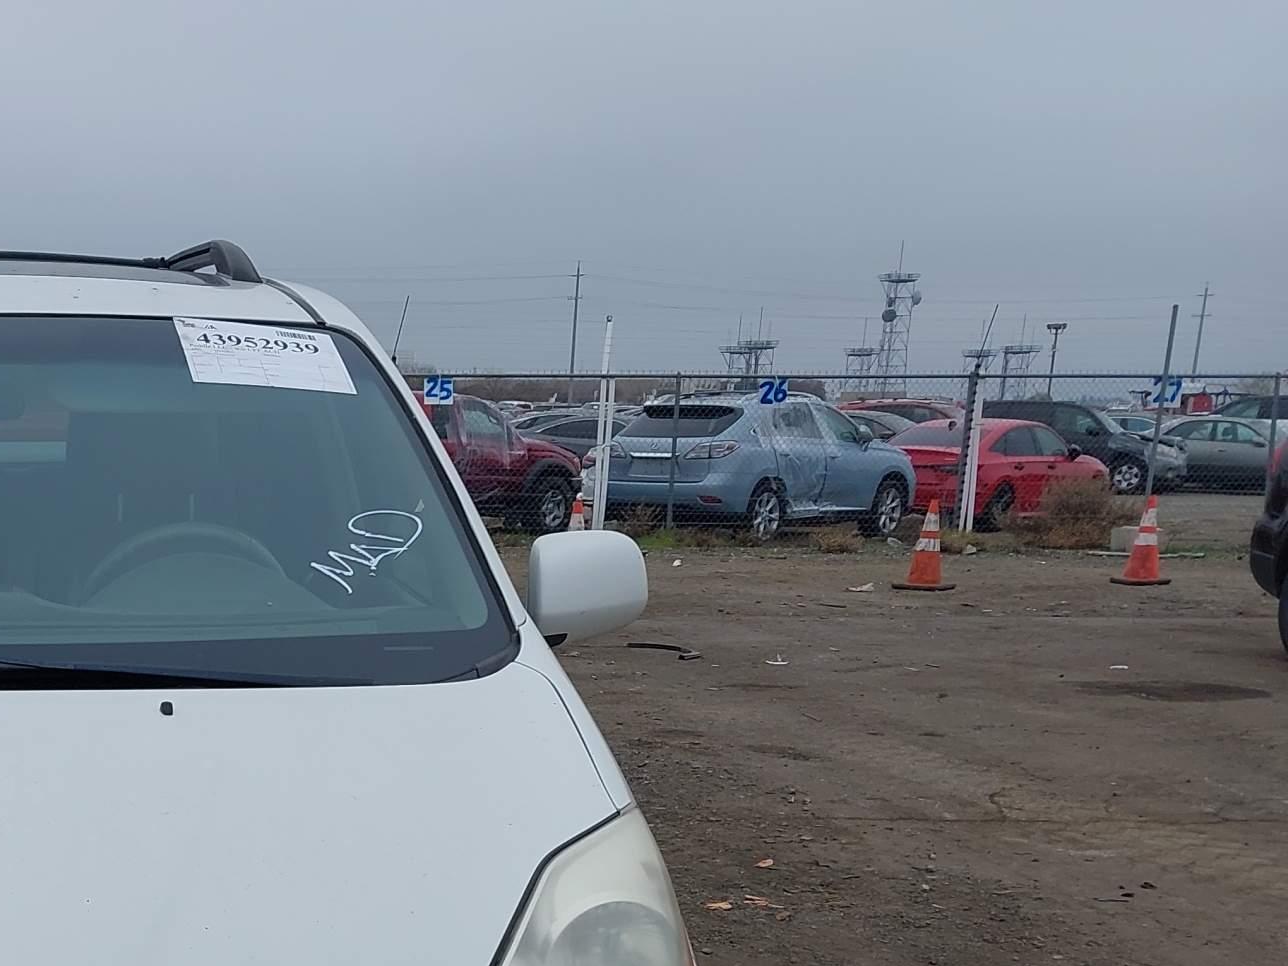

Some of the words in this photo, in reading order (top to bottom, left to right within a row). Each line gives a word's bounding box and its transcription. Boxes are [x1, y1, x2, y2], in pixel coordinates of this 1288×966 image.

[196, 332, 320, 355] 43952939
[425, 375, 453, 400] 25
[759, 377, 788, 404] 26
